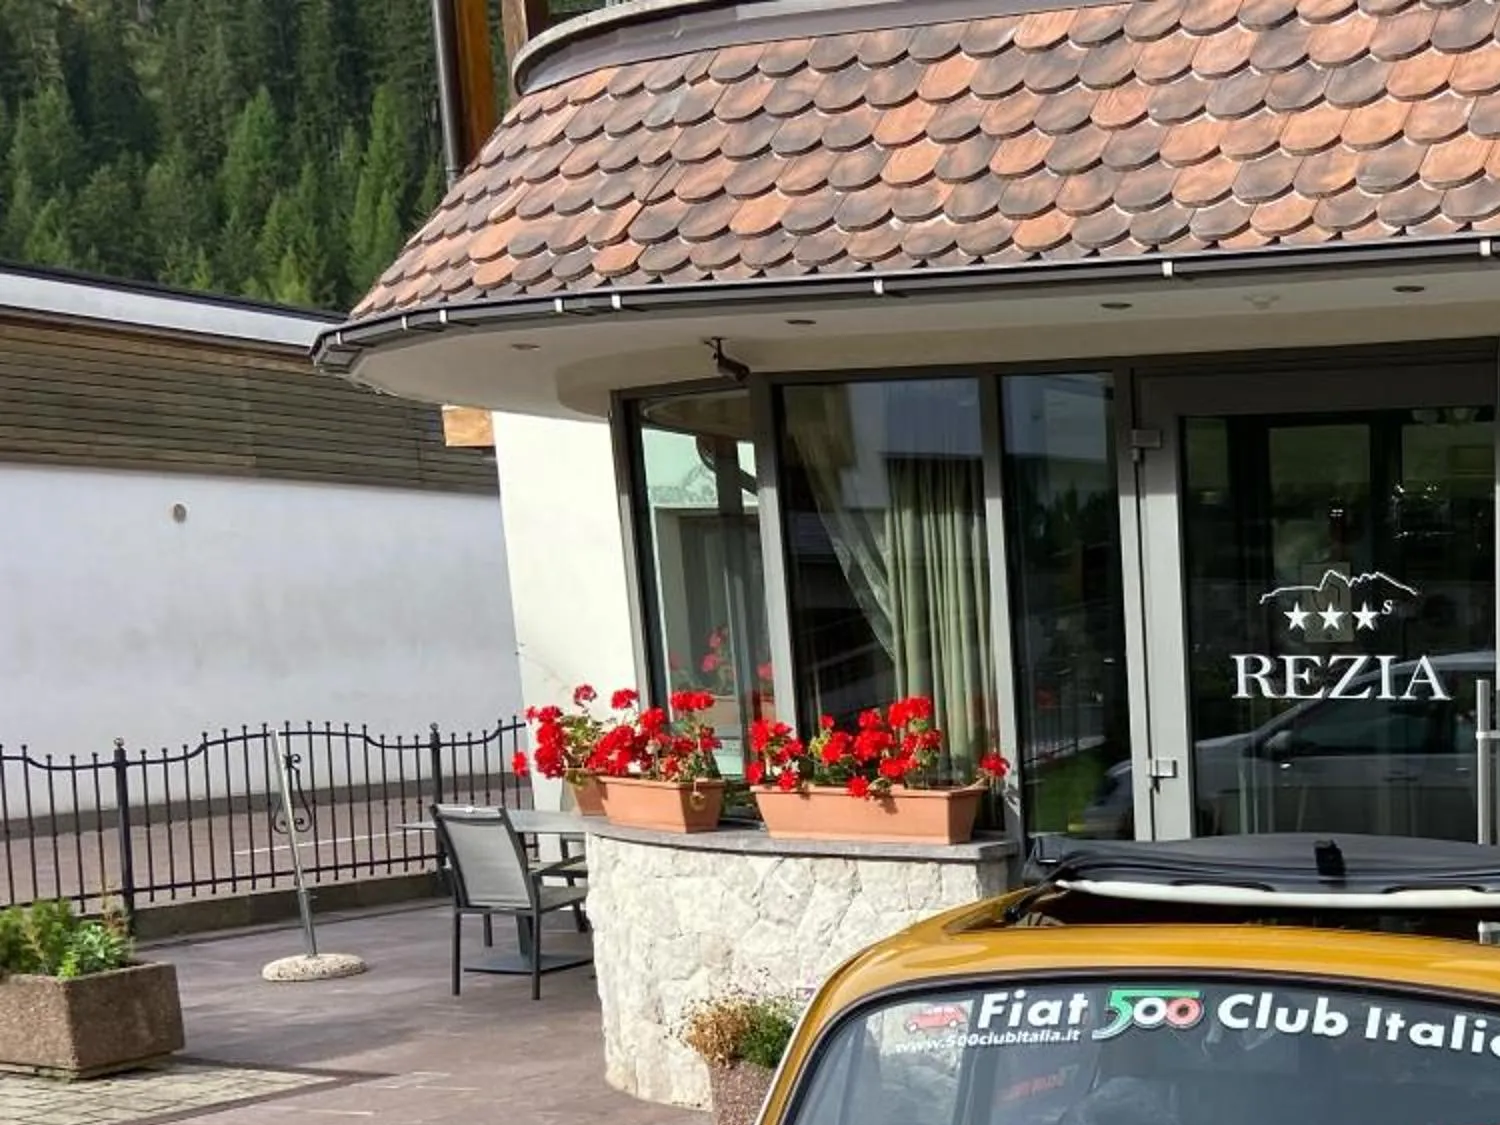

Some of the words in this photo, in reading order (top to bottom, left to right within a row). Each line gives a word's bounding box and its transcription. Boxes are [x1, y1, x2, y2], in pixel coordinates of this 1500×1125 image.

[1230, 653, 1453, 700] REZIA
[977, 988, 1089, 1028] Fiat
[1092, 988, 1203, 1039] 500
[1217, 991, 1349, 1037] Club
